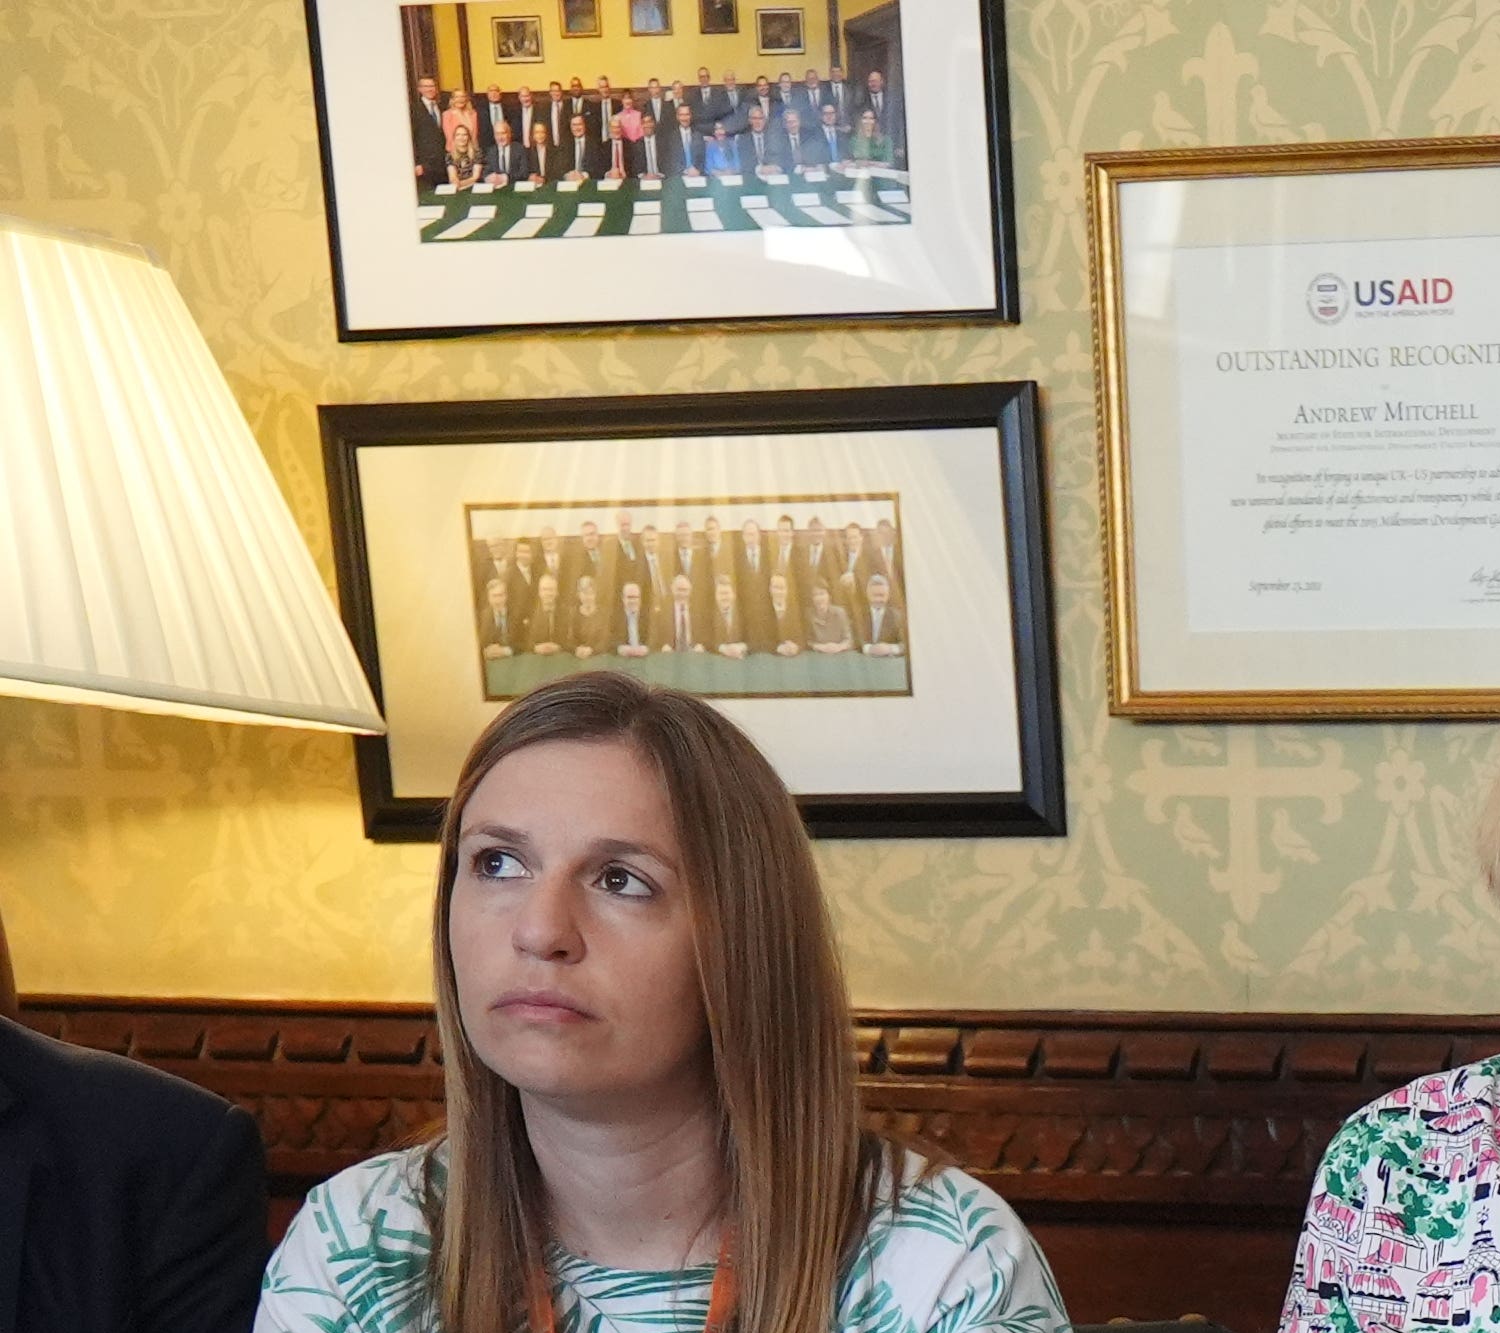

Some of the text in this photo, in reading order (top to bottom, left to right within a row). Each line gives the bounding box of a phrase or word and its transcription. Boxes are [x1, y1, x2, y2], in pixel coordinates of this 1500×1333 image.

[1354, 278, 1454, 307] USAID
[1216, 348, 1378, 372] OUTSTANDING
[1293, 401, 1480, 424] ANDREW MITCHELL
